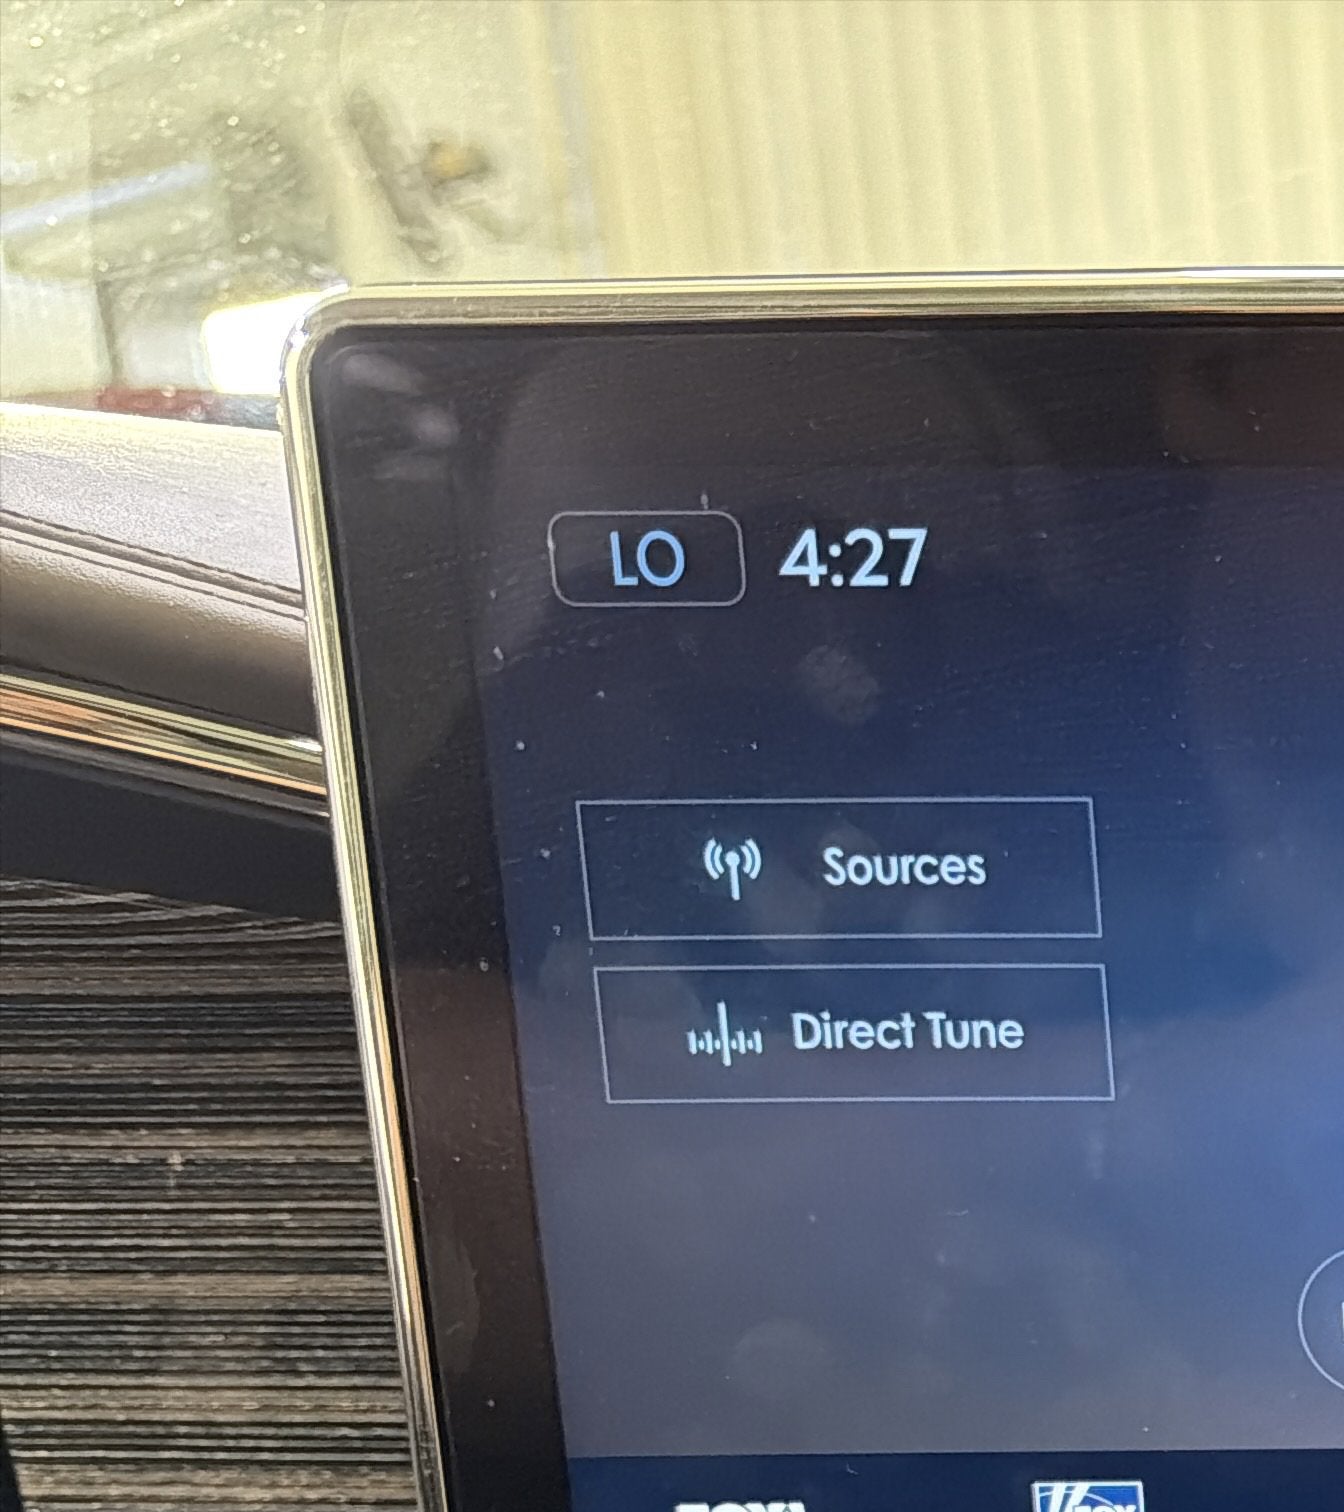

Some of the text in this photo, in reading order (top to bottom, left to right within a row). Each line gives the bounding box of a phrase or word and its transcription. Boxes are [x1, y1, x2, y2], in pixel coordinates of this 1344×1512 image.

[609, 529, 685, 587] LO
[778, 527, 928, 587] 4:27
[823, 846, 987, 886] Sources
[791, 1011, 1025, 1050] Direct Tune
